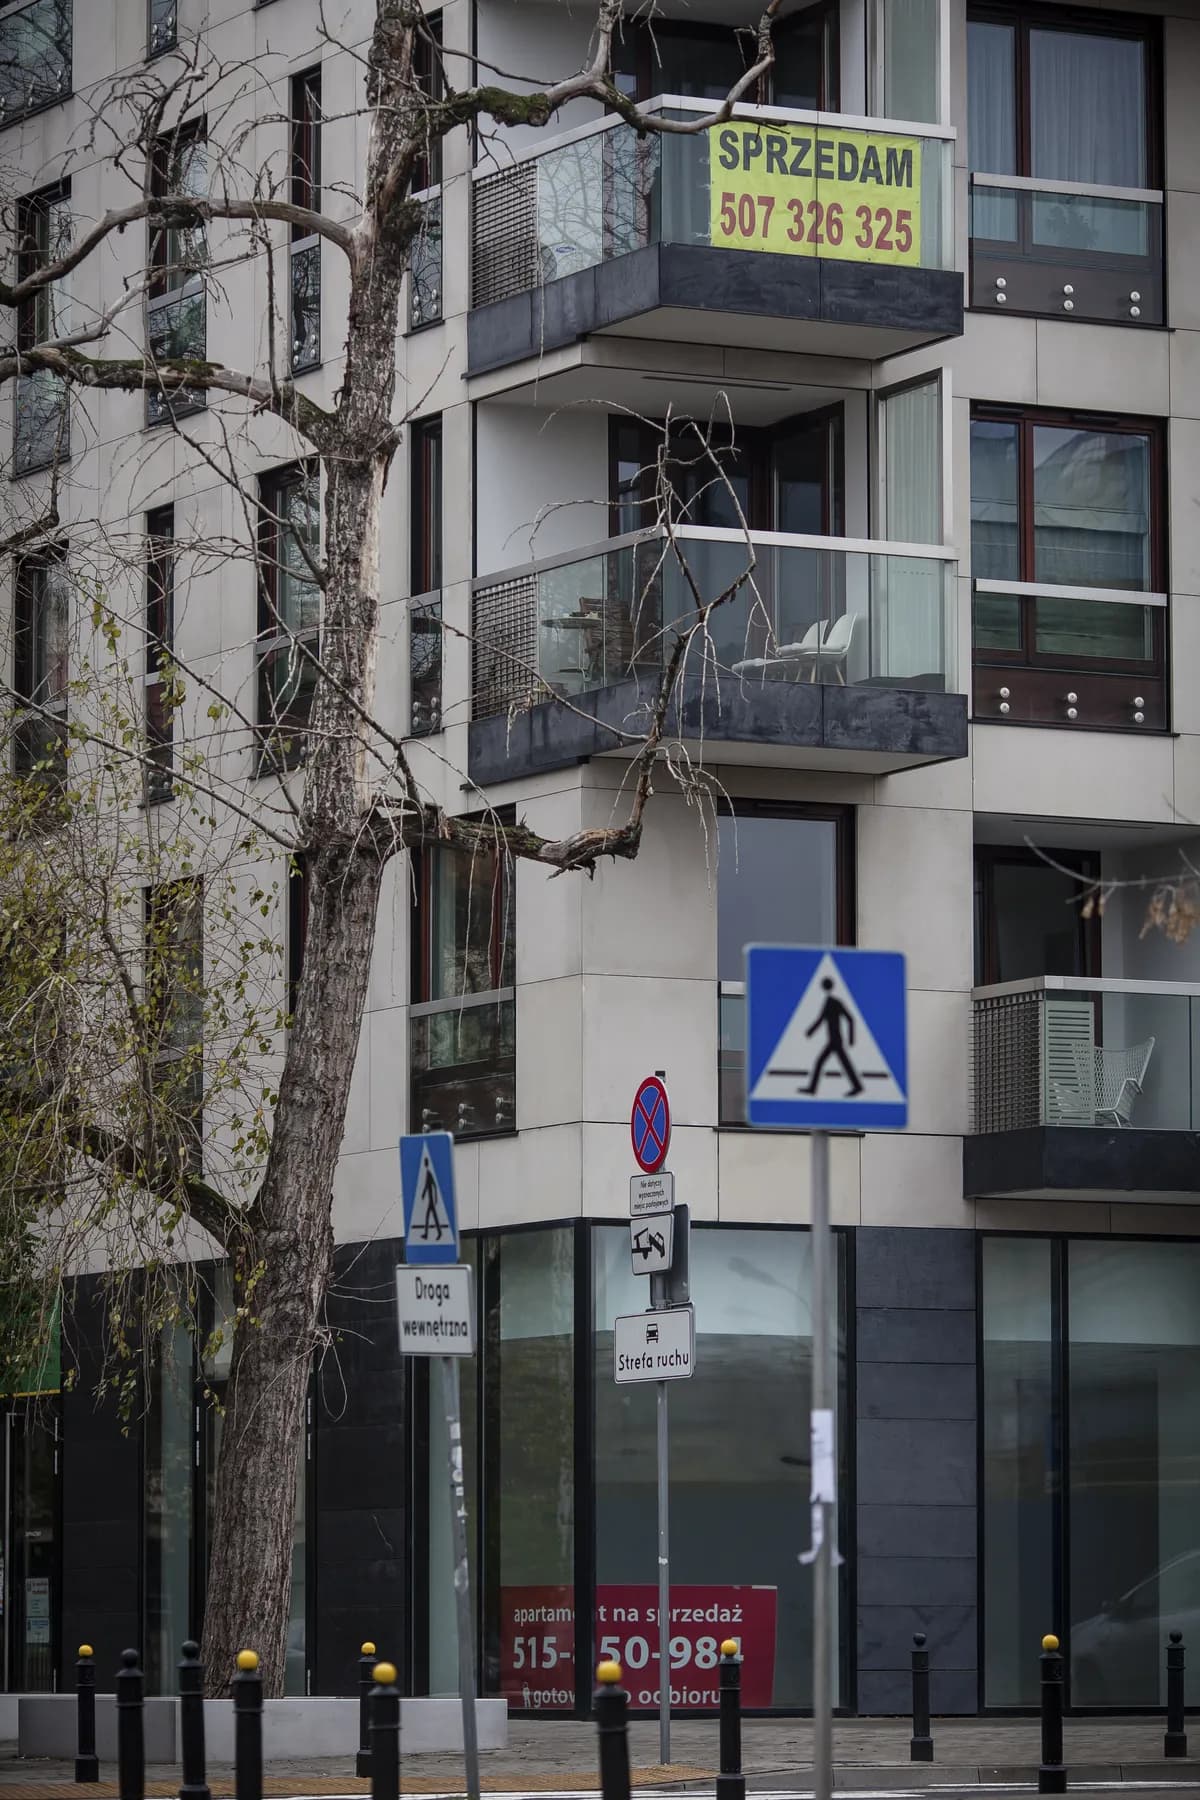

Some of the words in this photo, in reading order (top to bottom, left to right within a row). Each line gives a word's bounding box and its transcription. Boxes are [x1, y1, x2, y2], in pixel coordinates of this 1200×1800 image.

[719, 129, 913, 188] SPRZEDAM
[720, 192, 775, 238] 507
[787, 198, 844, 246] 326
[855, 205, 913, 252] 325
[415, 1276, 450, 1307] Droga
[402, 1314, 467, 1342] wewnętrzna
[618, 1352, 653, 1371] Strefa
[657, 1348, 689, 1368] ruchu
[613, 1608, 639, 1622] na
